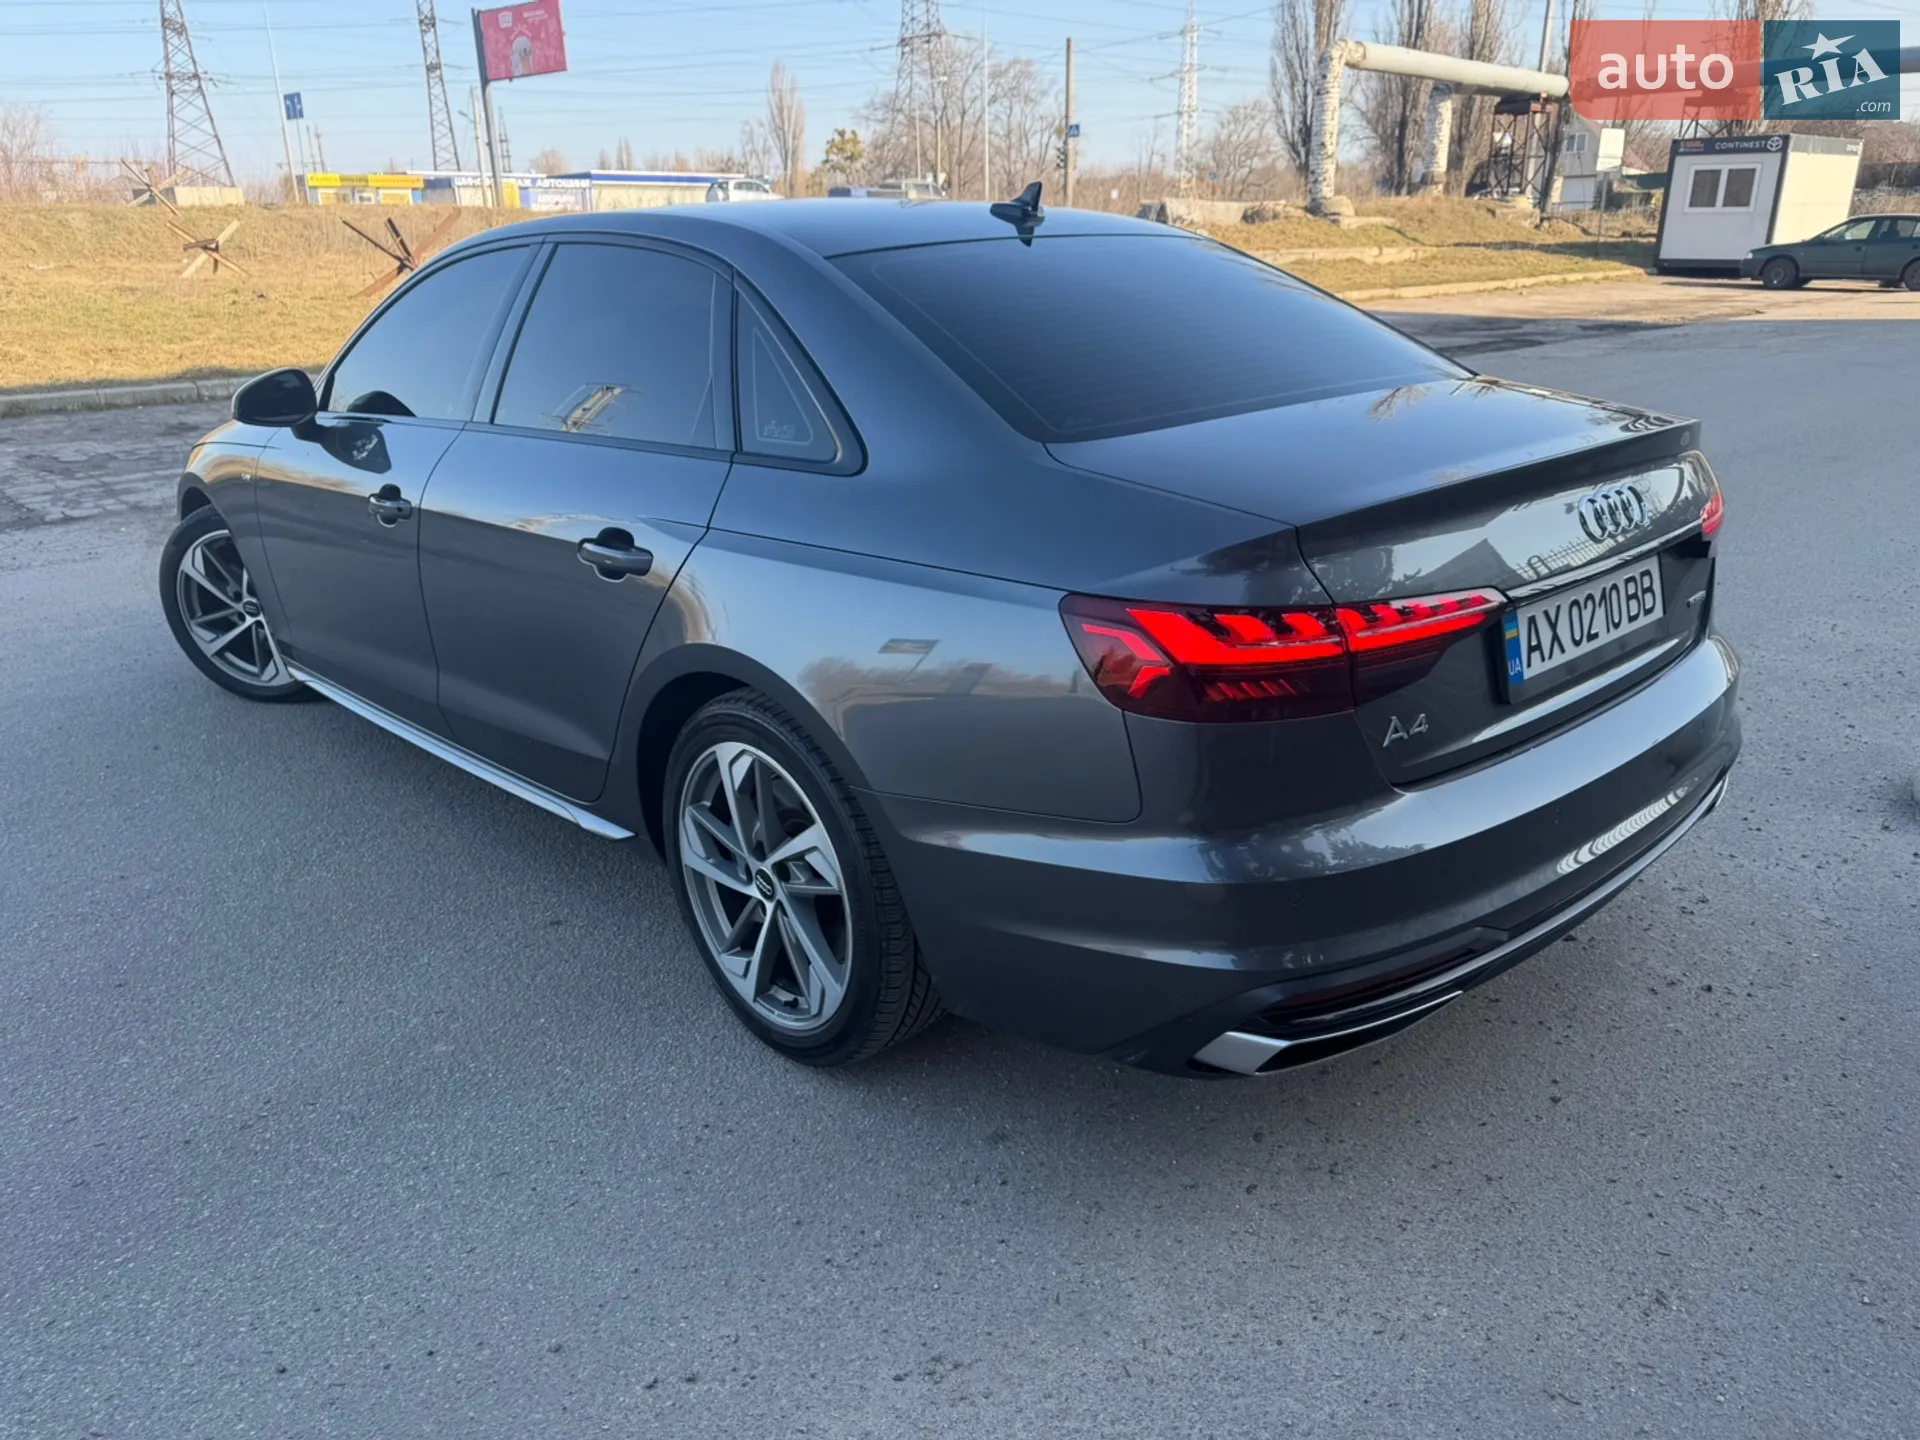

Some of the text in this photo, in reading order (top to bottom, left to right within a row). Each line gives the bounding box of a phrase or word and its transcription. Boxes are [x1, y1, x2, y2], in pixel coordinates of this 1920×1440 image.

[1714, 140, 1766, 150] CONTINEST
[1568, 582, 1622, 648] 0210
[1508, 658, 1522, 676] UA
[1382, 713, 1429, 748] A4
